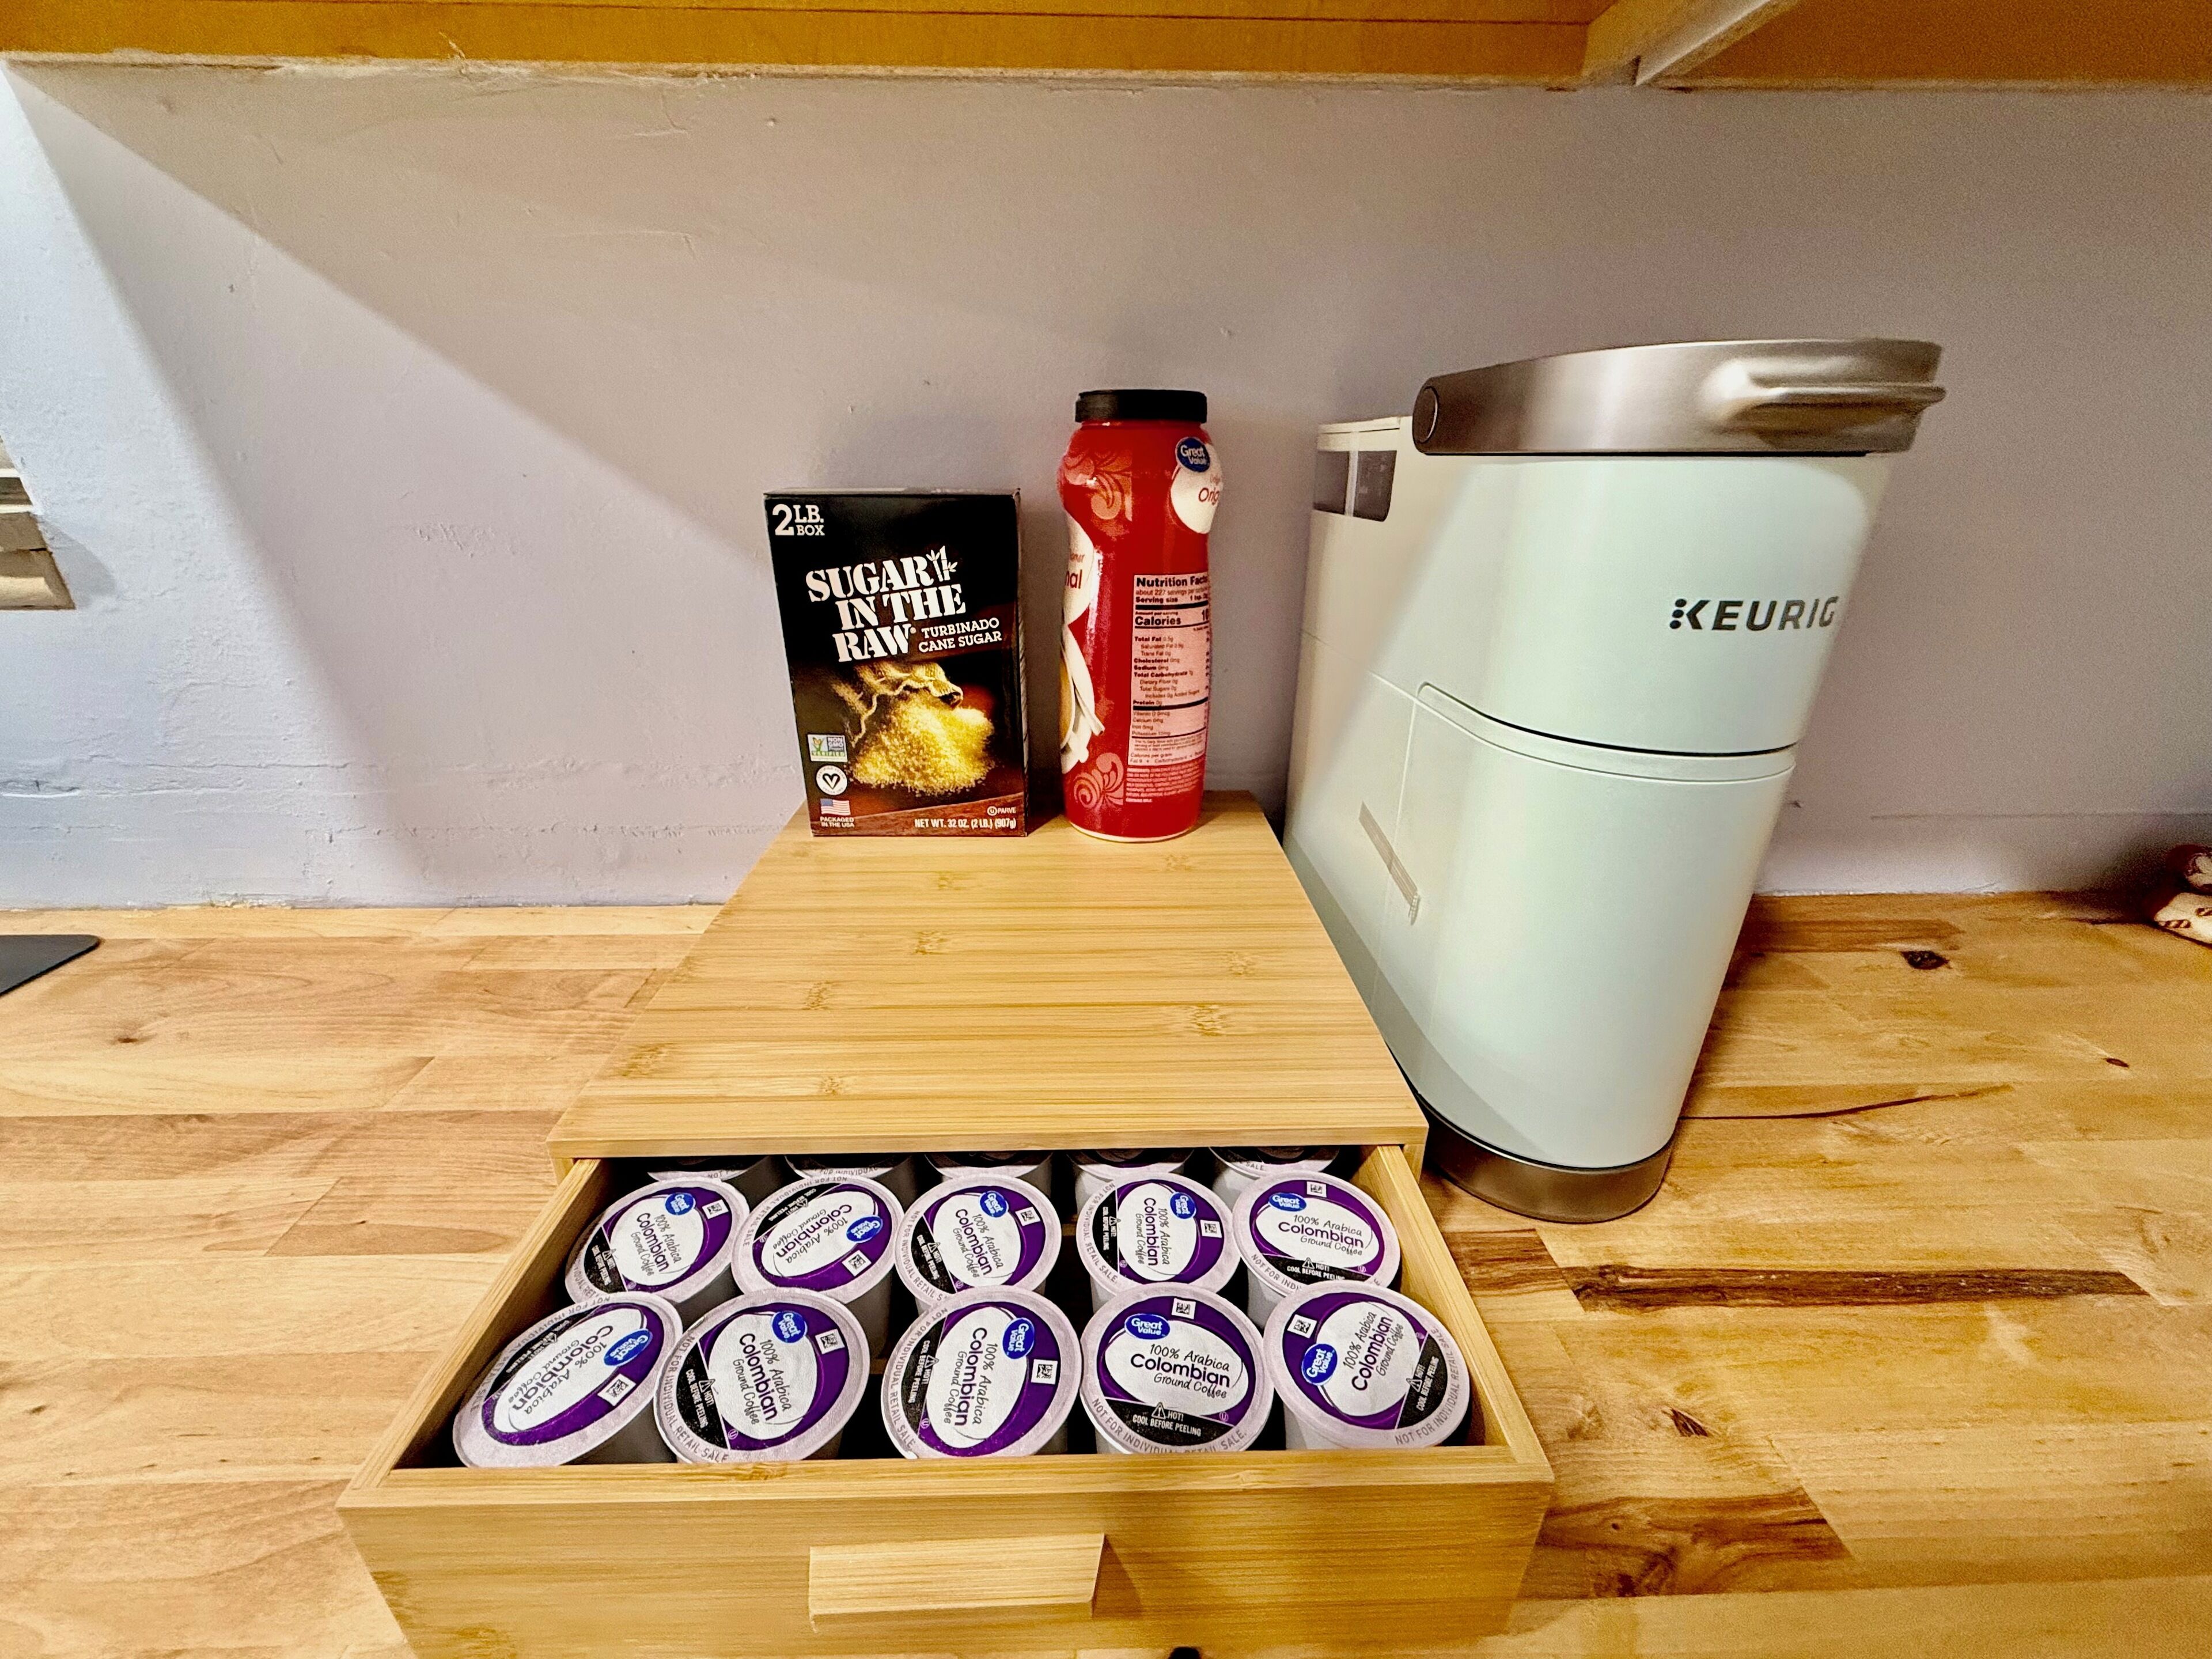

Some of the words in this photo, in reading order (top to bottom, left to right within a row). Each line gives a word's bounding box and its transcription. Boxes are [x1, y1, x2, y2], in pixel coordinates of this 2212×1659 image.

[1180, 445, 1205, 457] Great
[772, 503, 794, 536] 2
[797, 525, 825, 536] BOX
[806, 556, 934, 602] SUGAR
[1137, 577, 1187, 586] Nutrition
[835, 596, 878, 630] IN
[883, 584, 966, 624] THE
[1135, 616, 1181, 625] Calories
[1670, 596, 1839, 631] KEURIG
[922, 617, 999, 639] TURBINADO
[918, 638, 956, 653] CANE
[959, 631, 1002, 647] SUGAR
[915, 819, 929, 827] NET
[931, 819, 946, 827] WT.
[948, 819, 957, 827] 32
[958, 819, 969, 828] OZ.
[995, 818, 1016, 829] (907g)
[1272, 1195, 1300, 1204] Great
[654, 1214, 671, 1232] 100%
[776, 1205, 852, 1257] Colombian
[800, 1209, 827, 1229] Ground
[824, 1217, 848, 1236] 100%
[1136, 1213, 1144, 1238] Ground
[1158, 1208, 1169, 1228] 100%
[1294, 1215, 1319, 1225] 100%
[1323, 1221, 1362, 1236] Arabica
[631, 1232, 647, 1255] Ground
[637, 1213, 669, 1272] Colombian
[773, 1228, 800, 1249] Coffee
[956, 1209, 992, 1275] Colombian
[972, 1214, 990, 1233] 100%
[983, 1236, 1003, 1268] Arabica
[1144, 1198, 1158, 1266] Colombian
[1278, 1222, 1363, 1248] Colombian
[662, 1234, 682, 1263] Arabica
[785, 1233, 820, 1263] Arabica
[953, 1228, 968, 1253] Ground
[965, 1253, 979, 1278] Coffee
[1085, 1243, 1100, 1267] RETAIL
[1135, 1240, 1145, 1264] Coffee
[1159, 1231, 1172, 1265] Arabica
[1300, 1236, 1331, 1248] Ground
[1335, 1243, 1362, 1256] Coffee
[1251, 1254, 1264, 1265] NOT
[1265, 1267, 1279, 1281] FOR
[1302, 1268, 1322, 1278] BEFORE
[914, 1278, 935, 1297] RETAIL
[783, 1313, 801, 1336] Great
[932, 1308, 948, 1322] NOT
[1131, 1318, 1162, 1330] Great
[915, 1323, 931, 1337] FOR
[1007, 1329, 1016, 1351] Value
[1014, 1323, 1029, 1351] Great
[1138, 1327, 1161, 1335] Value
[1343, 1343, 1361, 1369] 100%
[1354, 1312, 1377, 1342] Arabica
[541, 1340, 579, 1371] Ground
[575, 1343, 607, 1368] 100%
[681, 1336, 695, 1353] NOT
[983, 1343, 998, 1370] 100%
[1150, 1344, 1180, 1359] 100%
[1184, 1350, 1229, 1372] Arabica
[1352, 1317, 1393, 1391] Colombian
[1376, 1346, 1395, 1377] Ground
[1387, 1323, 1403, 1350] Coffee
[513, 1325, 613, 1410] Colombian
[670, 1355, 682, 1372] FOR
[760, 1340, 780, 1364] 100%
[770, 1369, 791, 1411] Arabica
[890, 1337, 915, 1389] INDIVIDUAL
[950, 1351, 967, 1386] Ground
[1131, 1354, 1229, 1387] Colombian
[1306, 1348, 1327, 1377] Great
[1319, 1351, 1334, 1373] Value
[509, 1370, 542, 1404] Coffee
[739, 1334, 778, 1421] Colombian
[955, 1328, 987, 1426] Colombian
[1154, 1373, 1192, 1390] Ground
[1193, 1381, 1227, 1399] Coffee
[524, 1370, 570, 1415] Arabica
[663, 1375, 677, 1427] INDIVIDUAL
[733, 1359, 750, 1392] Ground
[744, 1392, 759, 1425] Coffee
[944, 1387, 960, 1424] Coffee
[972, 1374, 991, 1425] Arabica
[1395, 1434, 1415, 1445] NOT
[1416, 1423, 1435, 1439] FOR
[1433, 1387, 1460, 1426] INDIVIDUAL
[1448, 1351, 1460, 1382] RETAIL
[888, 1391, 902, 1425] RETAIL
[1092, 1398, 1107, 1415] NOT
[1105, 1415, 1123, 1437] FOR
[1168, 1411, 1184, 1421] HOT!
[1132, 1414, 1147, 1426] COOL
[1150, 1417, 1173, 1429] BEFORE
[1175, 1422, 1202, 1436] PEELING
[675, 1427, 700, 1453] RETAIL
